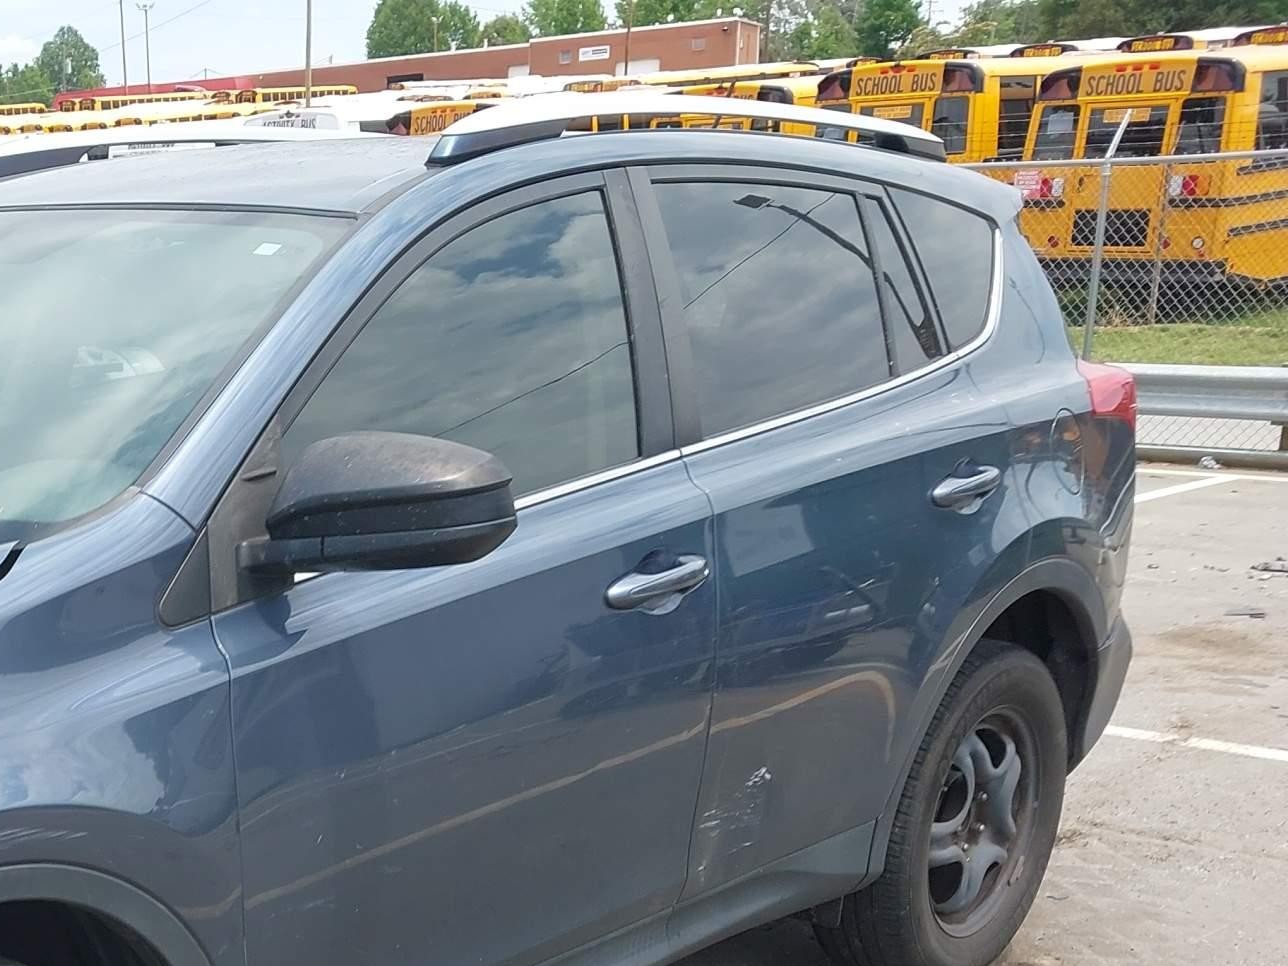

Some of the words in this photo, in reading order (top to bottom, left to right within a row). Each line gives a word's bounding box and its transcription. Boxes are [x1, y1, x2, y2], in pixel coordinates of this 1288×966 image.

[856, 74, 904, 97] SCHOOL
[911, 72, 937, 93] BUS
[1085, 73, 1144, 97] SCHOOL
[1152, 69, 1187, 93] BUS
[414, 113, 450, 133] SCHOOL
